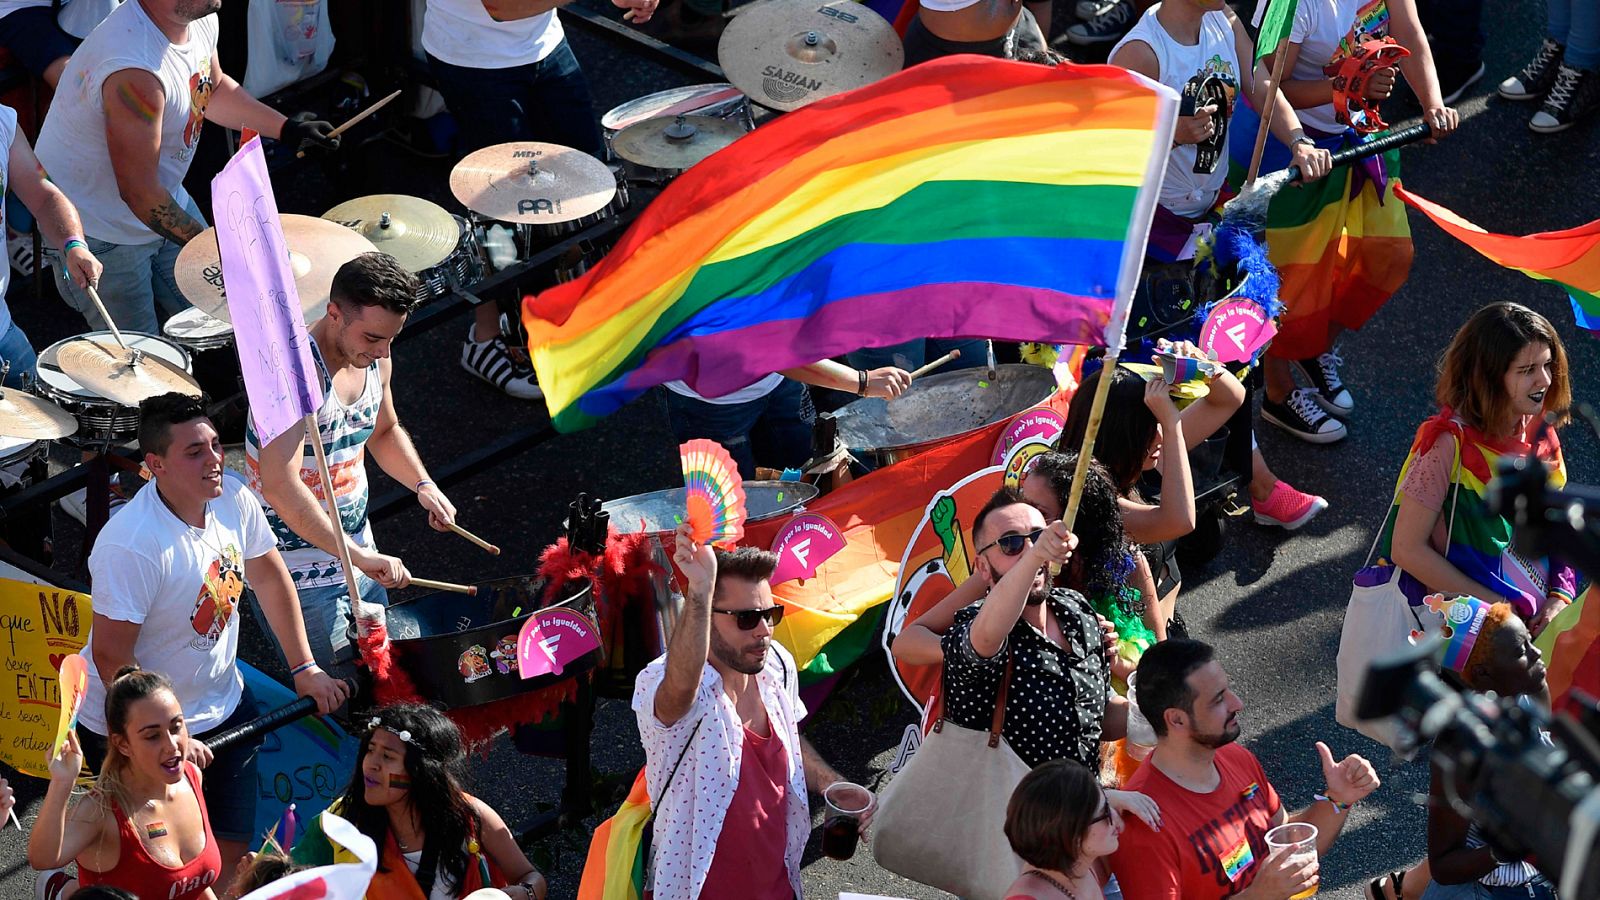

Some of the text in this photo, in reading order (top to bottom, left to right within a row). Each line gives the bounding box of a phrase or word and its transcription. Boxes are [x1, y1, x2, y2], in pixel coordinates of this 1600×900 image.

[762, 65, 822, 91] SABIAN
[1227, 309, 1236, 317] la
[1014, 423, 1027, 438] por
[784, 530, 794, 544] por
[794, 525, 802, 533] la
[0, 591, 80, 657] que NO
[530, 624, 541, 638] por
[542, 619, 551, 628] la
[1468, 606, 1488, 636] MADRID
[168, 869, 216, 900] Ciao
